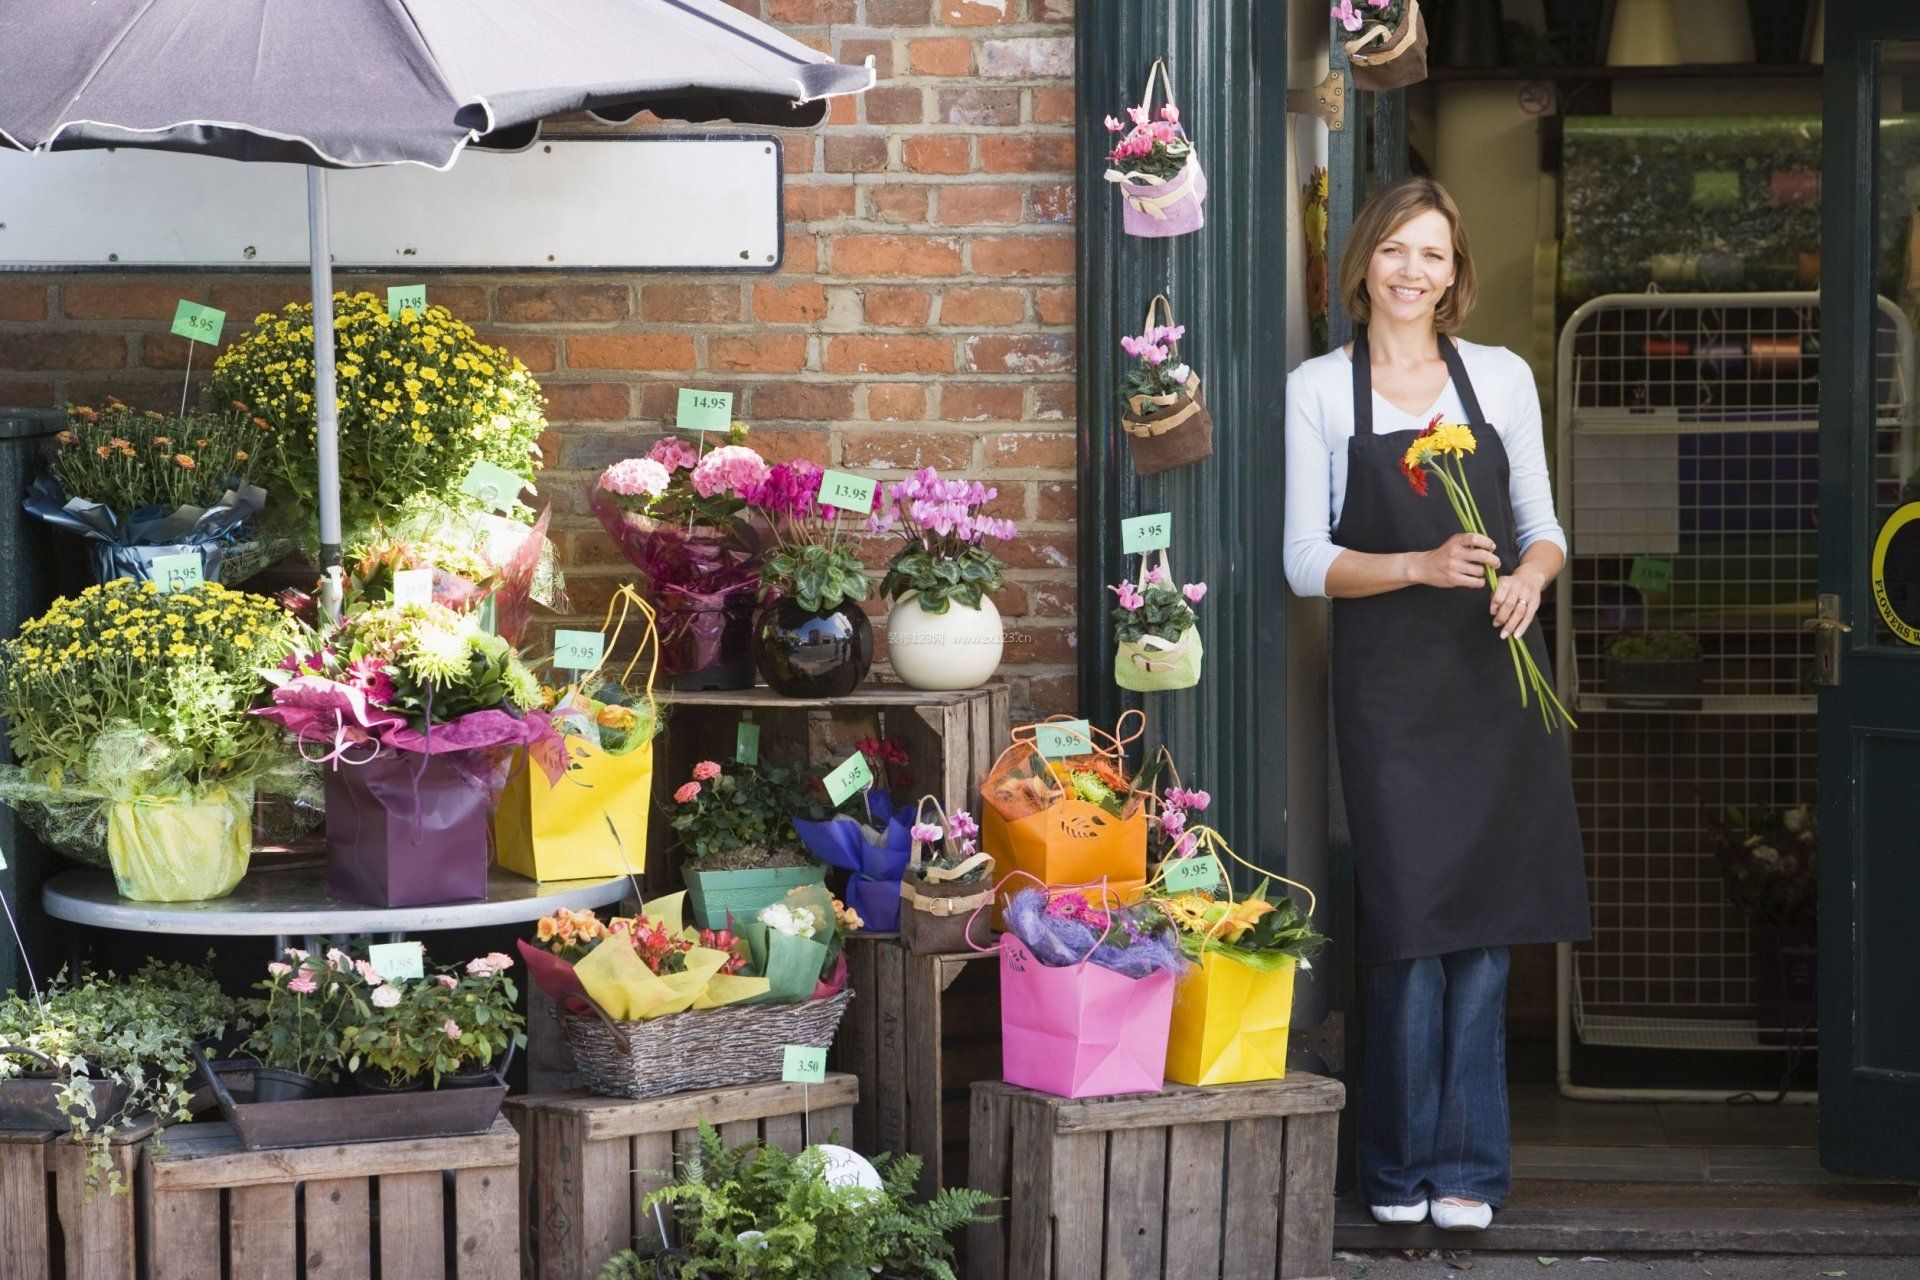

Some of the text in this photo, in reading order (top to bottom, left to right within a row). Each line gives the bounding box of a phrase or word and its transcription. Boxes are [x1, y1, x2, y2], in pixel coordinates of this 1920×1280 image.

[400, 297, 421, 309] 1295
[189, 315, 214, 332] 8.95
[694, 396, 726, 410] 14.95
[835, 484, 867, 501] 13.95
[1138, 524, 1162, 539] 395
[168, 567, 197, 582] 1295
[1875, 580, 1911, 638] FLOWERS
[571, 646, 594, 659] 9.95
[1054, 735, 1081, 748] 9.95
[841, 766, 861, 788] 1.95
[1181, 863, 1208, 878] 9.95
[797, 1060, 820, 1073] 3.50
